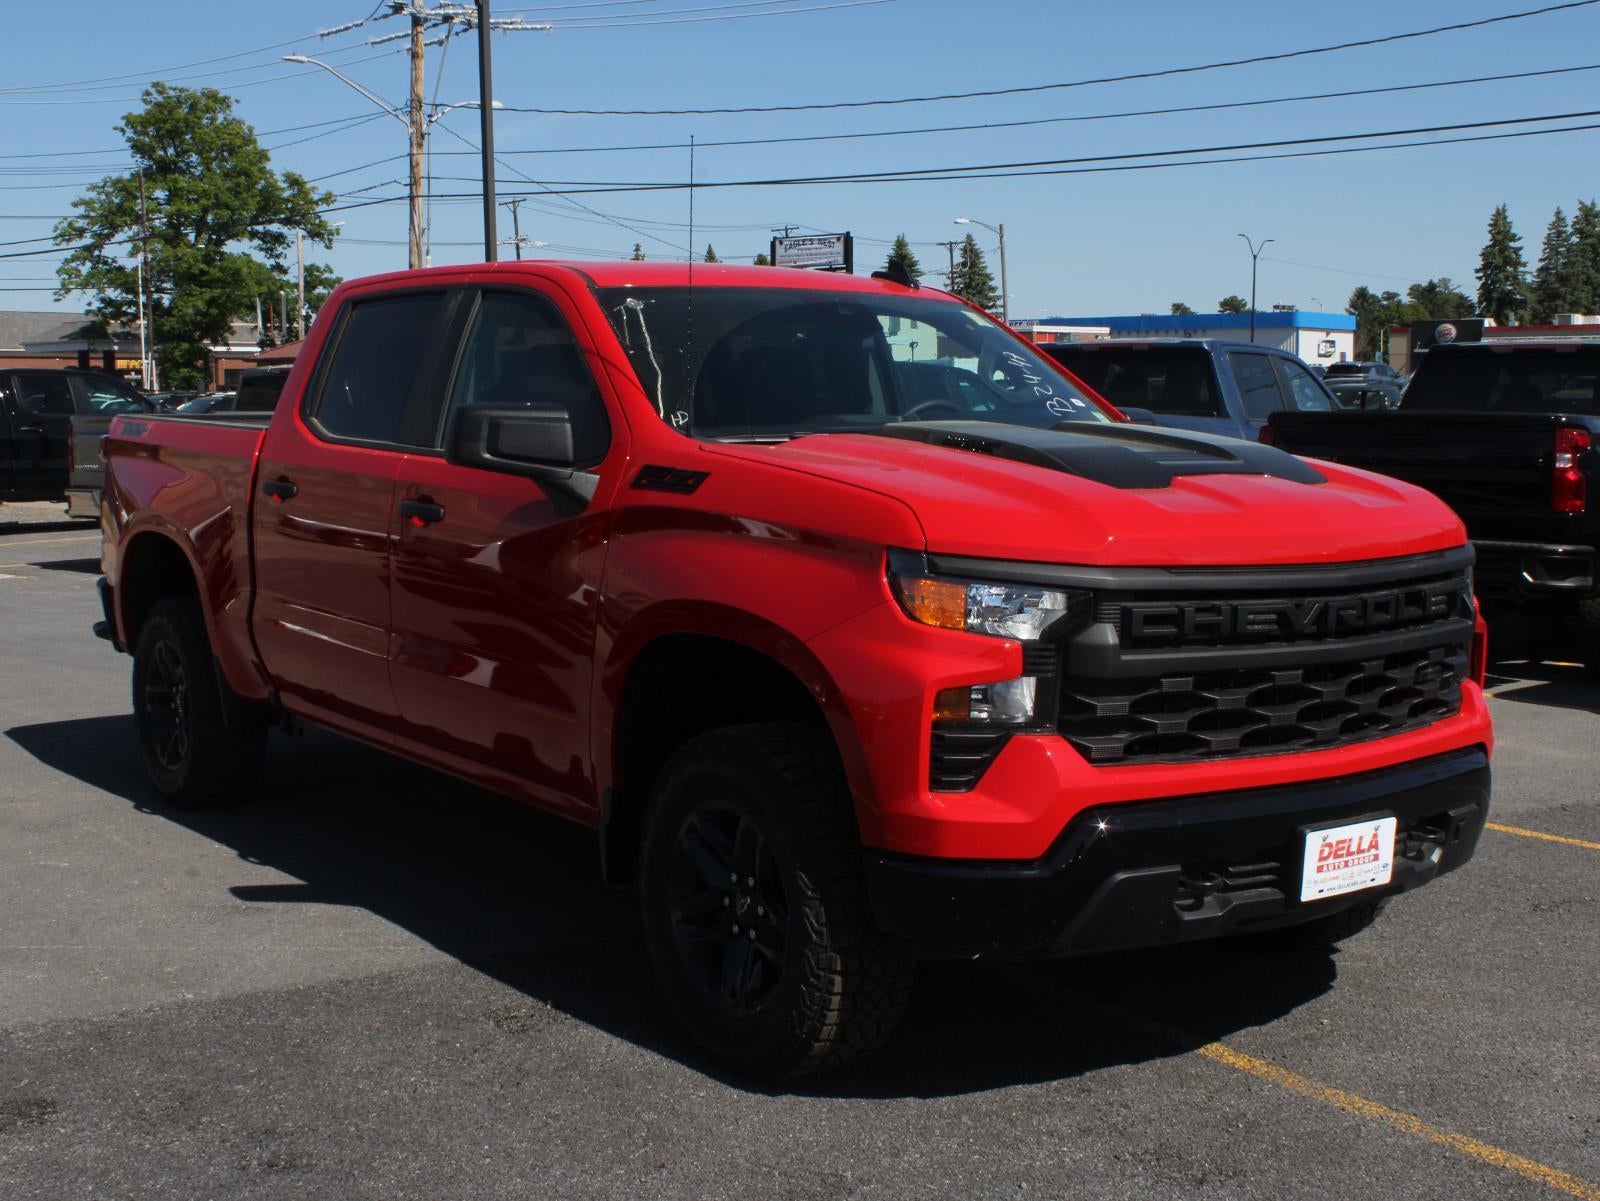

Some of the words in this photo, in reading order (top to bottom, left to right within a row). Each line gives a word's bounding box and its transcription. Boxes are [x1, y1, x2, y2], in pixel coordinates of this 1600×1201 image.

[1317, 832, 1379, 862] DELLA
[1322, 861, 1345, 872] AUTO
[1347, 854, 1375, 868] GROUP
